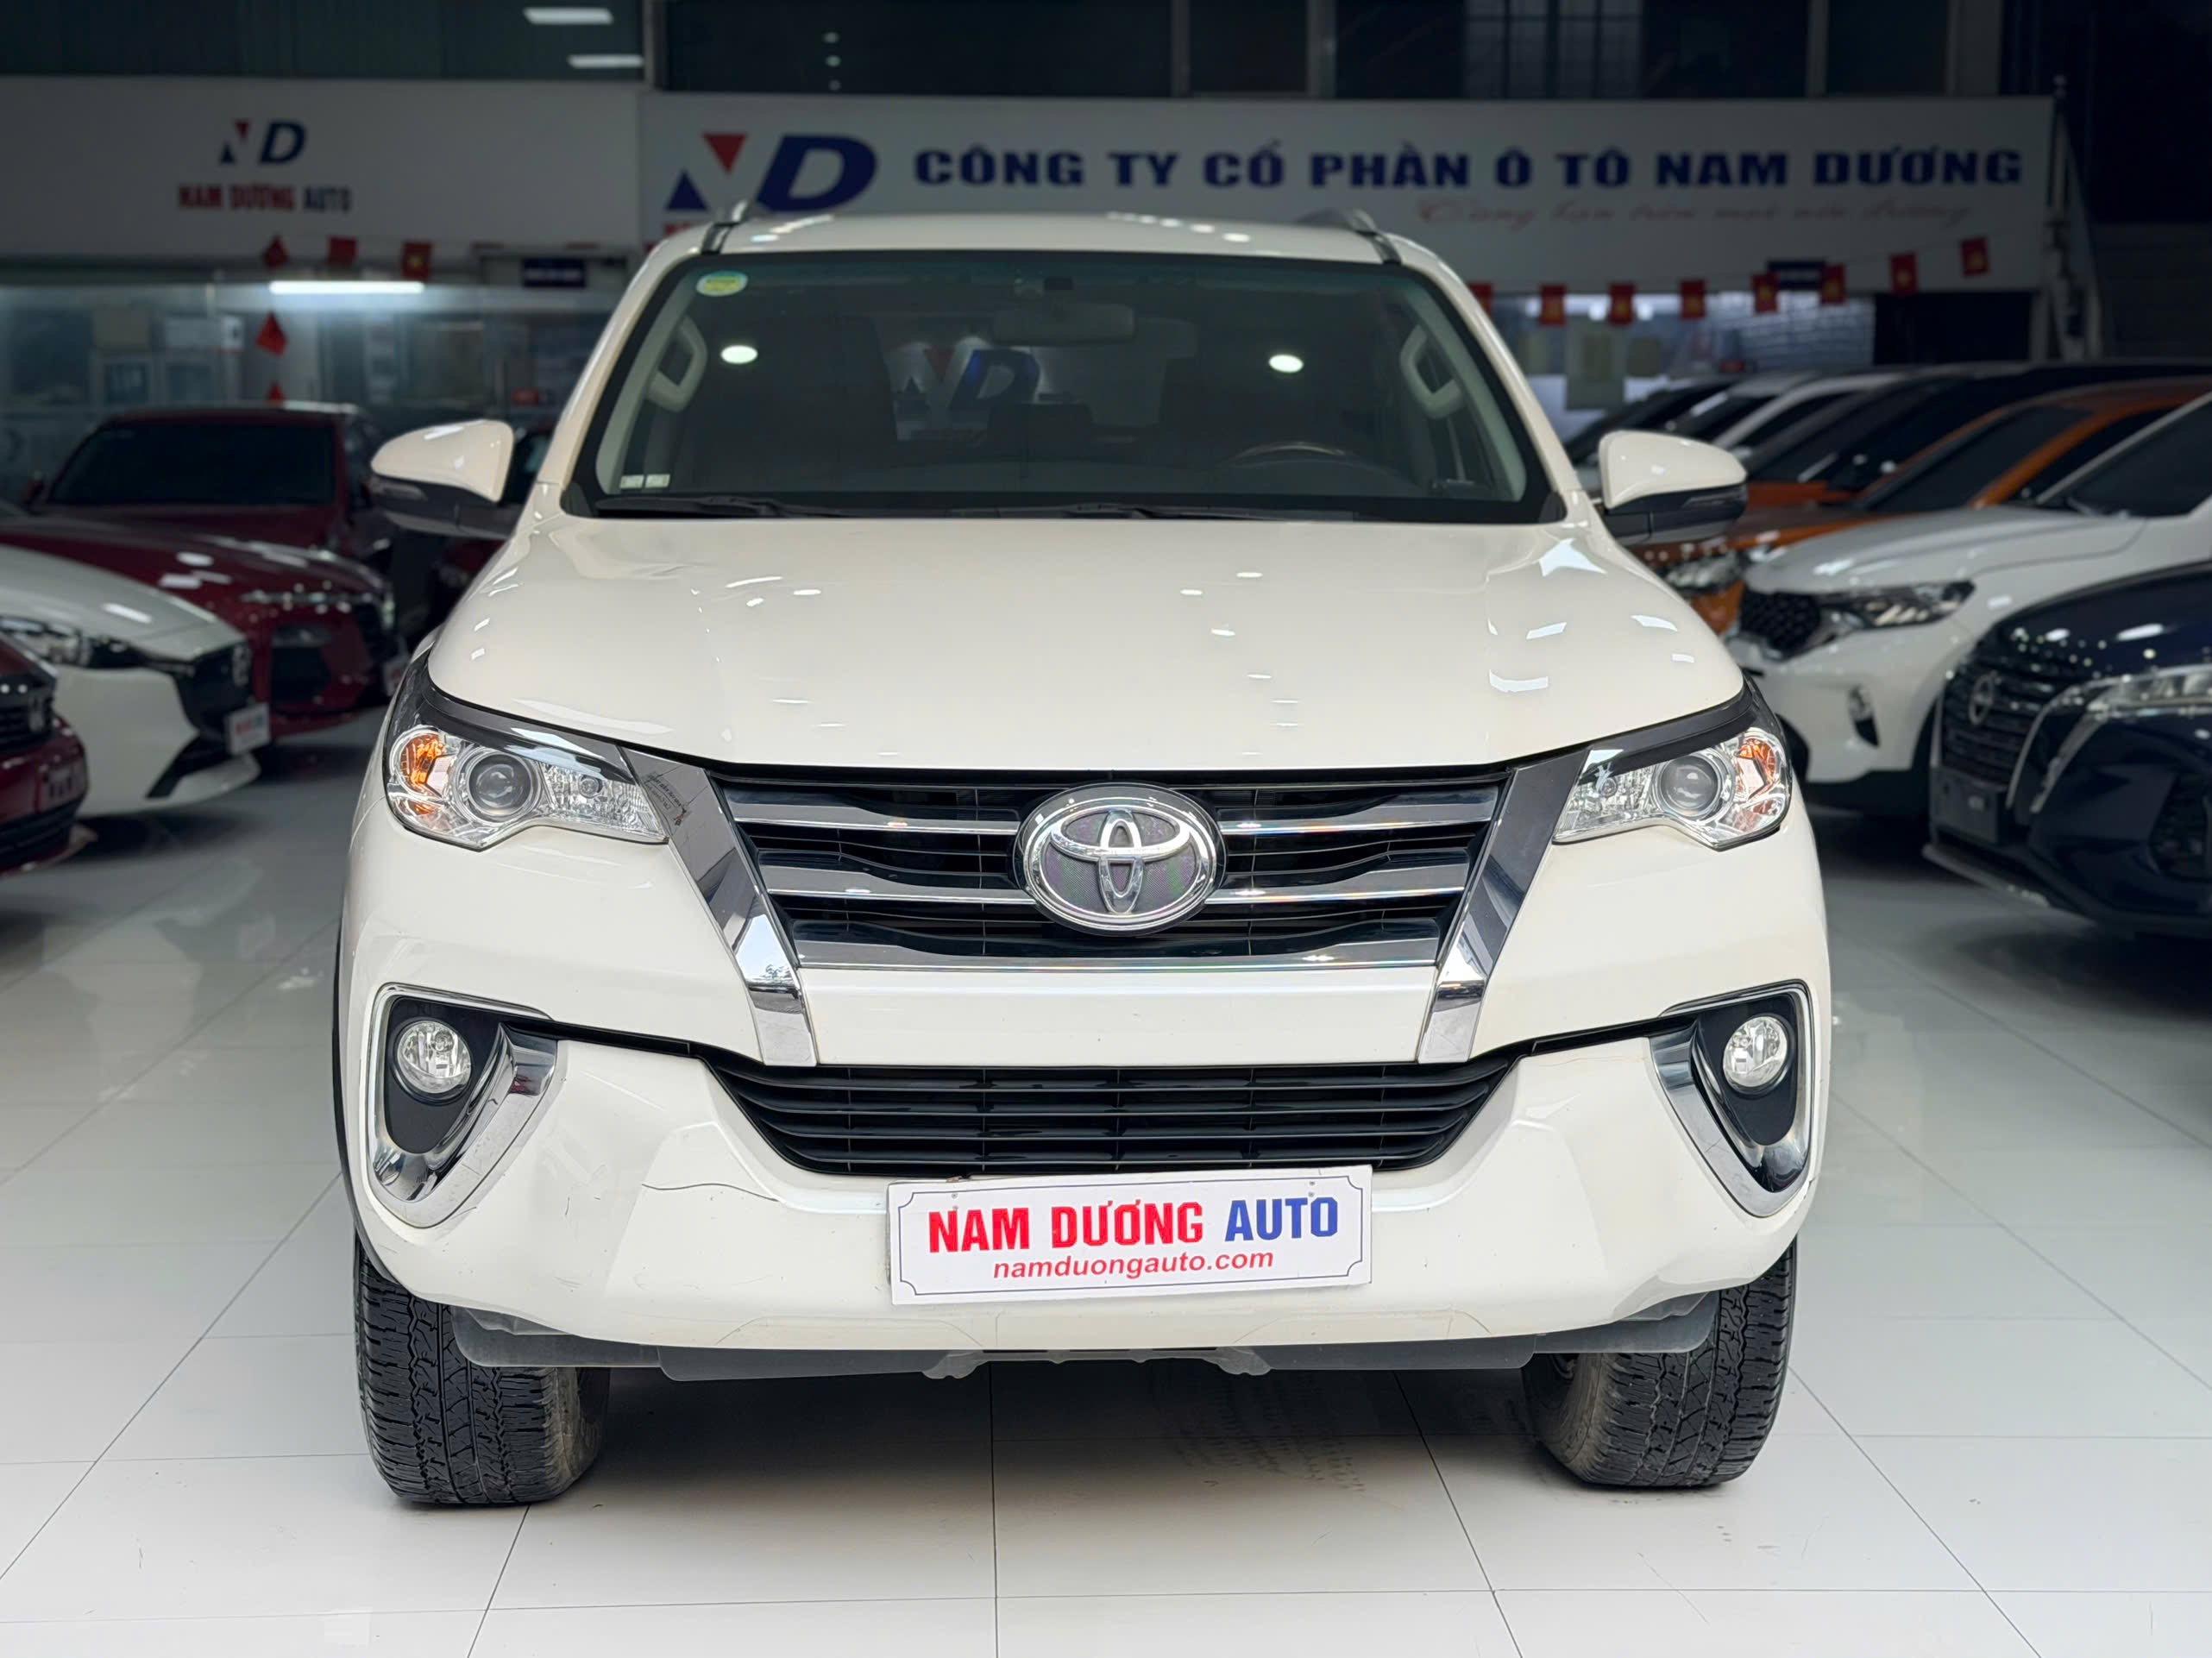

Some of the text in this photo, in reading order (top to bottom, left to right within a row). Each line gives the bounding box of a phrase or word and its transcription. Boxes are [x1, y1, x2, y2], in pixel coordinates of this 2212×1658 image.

[914, 145, 1084, 187] CÔNG
[1107, 151, 1179, 187] TY
[1493, 147, 1534, 188] Ô
[1555, 147, 1632, 188] TÔ
[1655, 150, 1789, 187] NAM
[1813, 144, 2023, 187] DƯƠNG
[179, 185, 223, 210] NAM
[928, 1196, 1338, 1253] NAM DƯƠNG AUTO
[993, 1249, 1274, 1281] namduongauto.com
